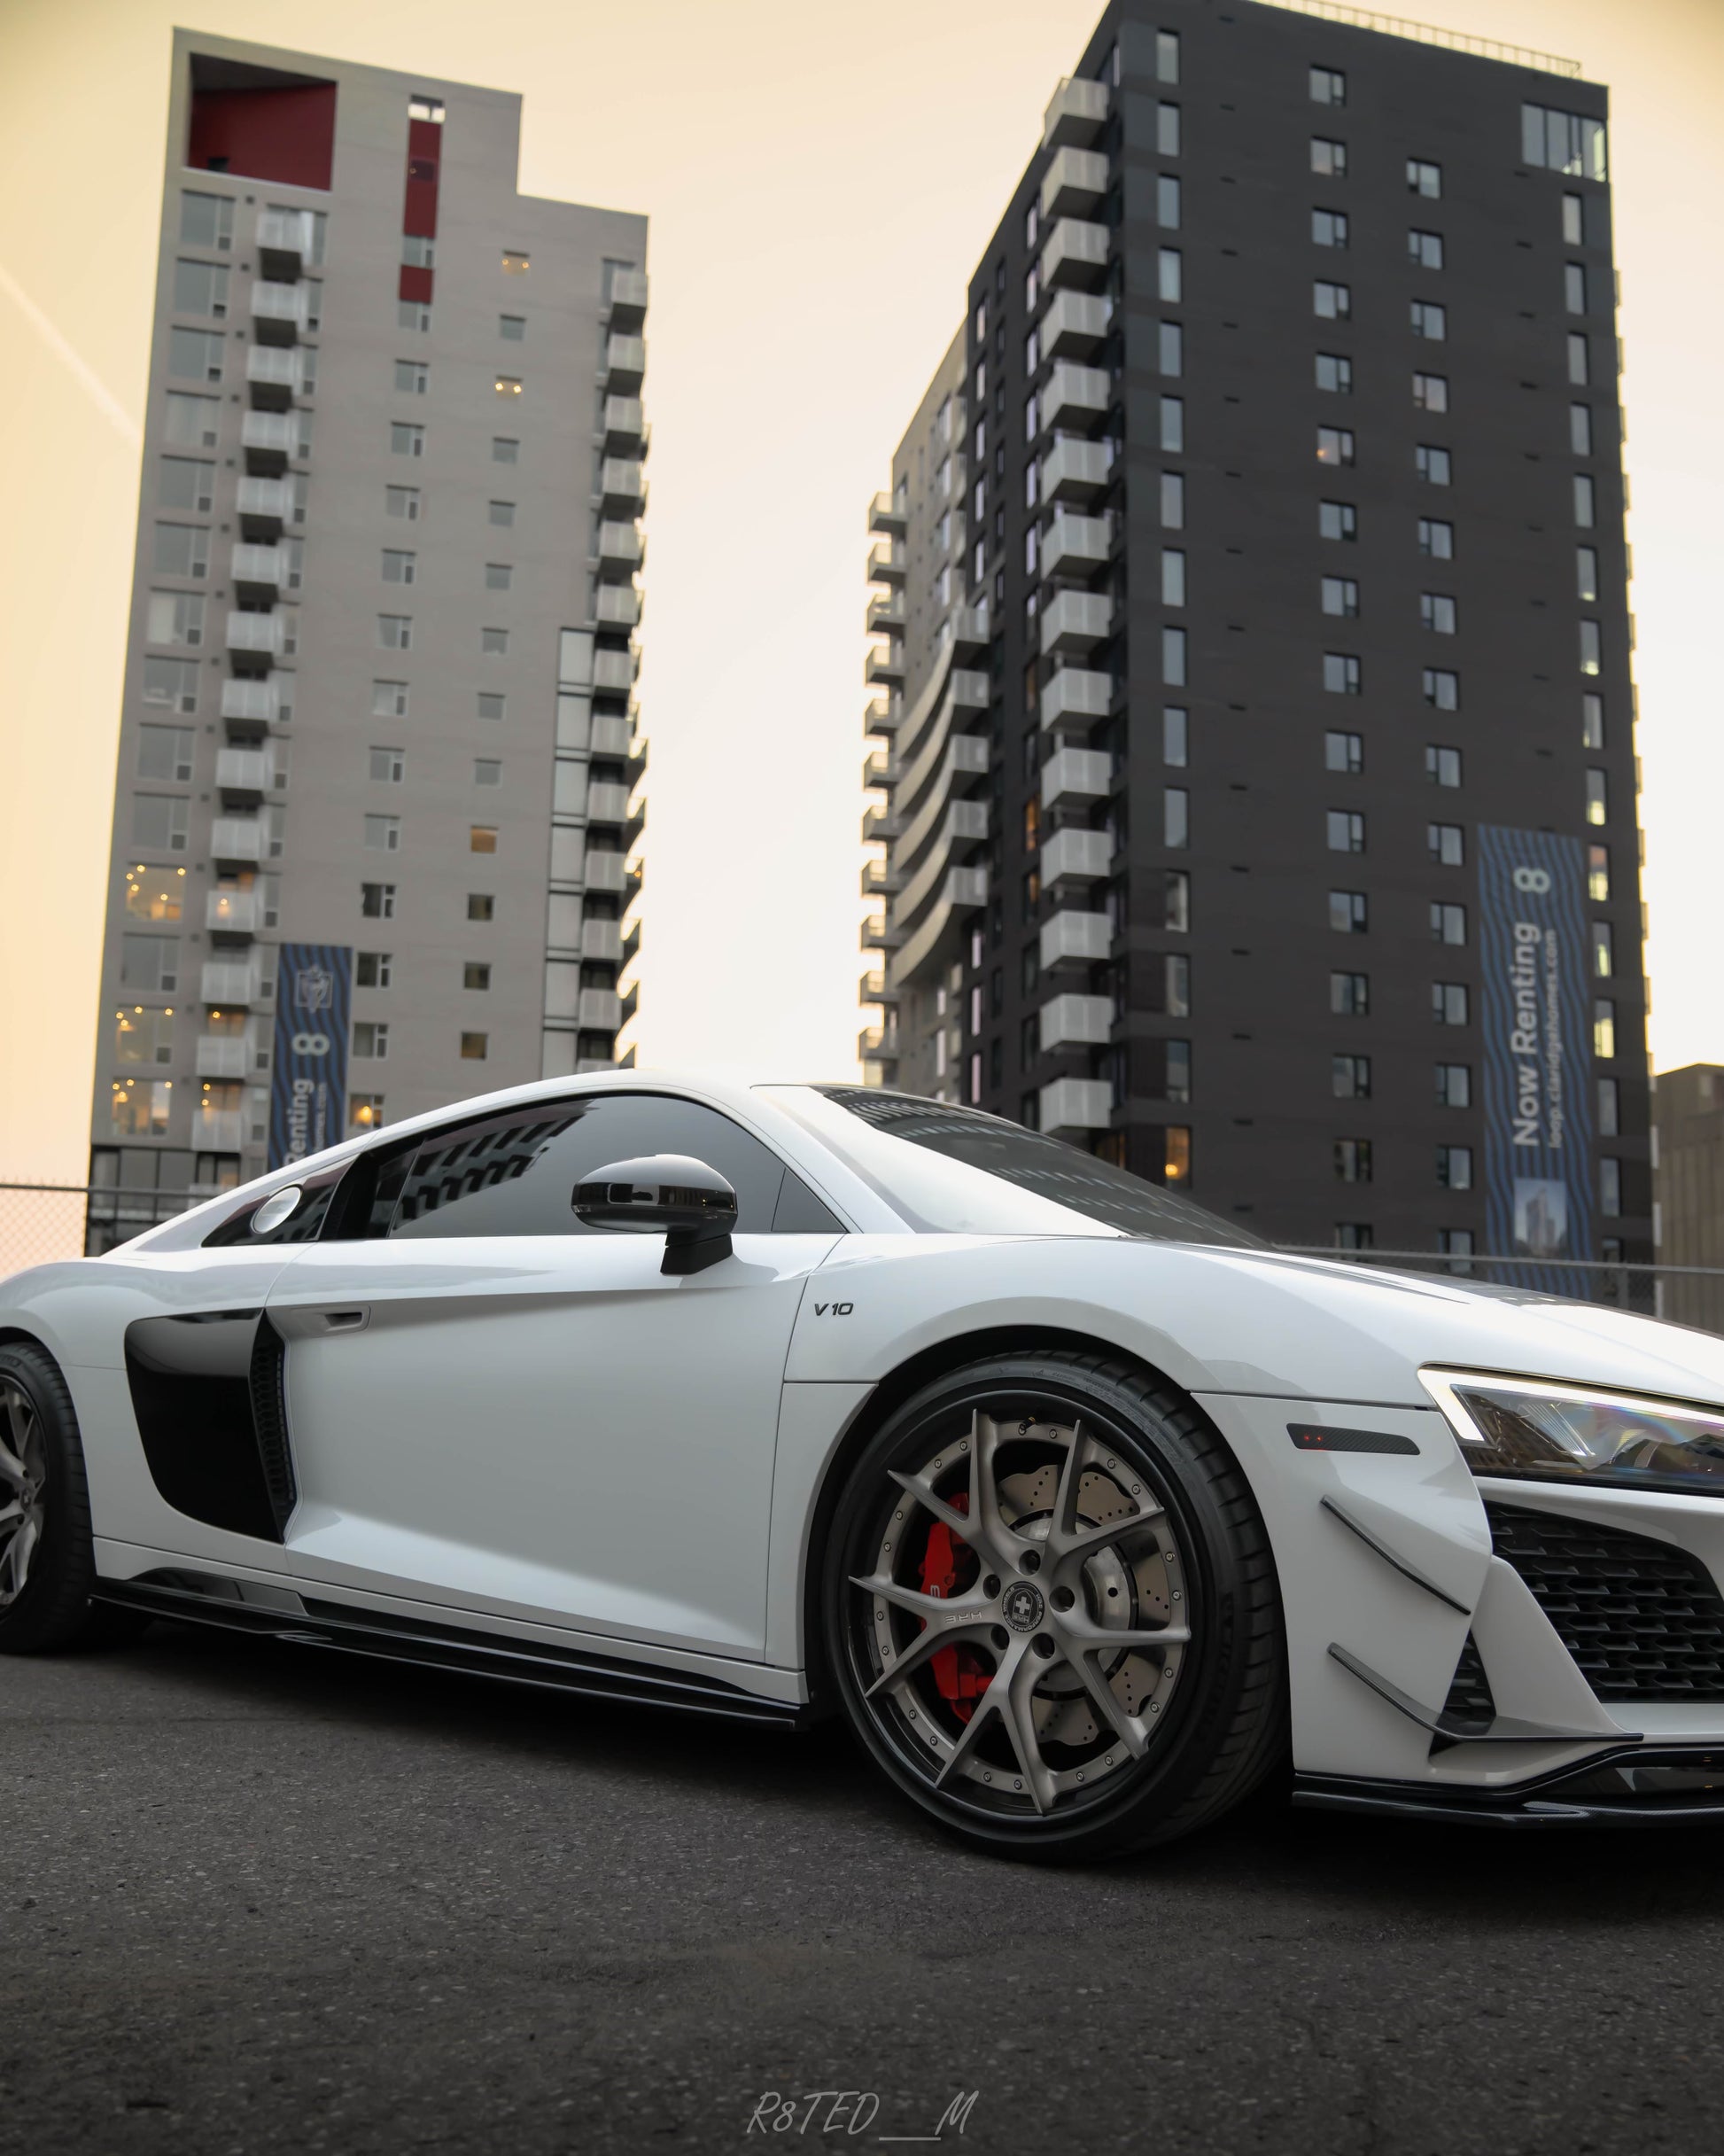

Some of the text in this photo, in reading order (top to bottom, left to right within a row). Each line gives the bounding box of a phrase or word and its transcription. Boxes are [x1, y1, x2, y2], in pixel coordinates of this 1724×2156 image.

[1512, 922, 1542, 1148] Now Renting
[814, 1303, 854, 1316] V10
[945, 1612, 982, 1623] HRE
